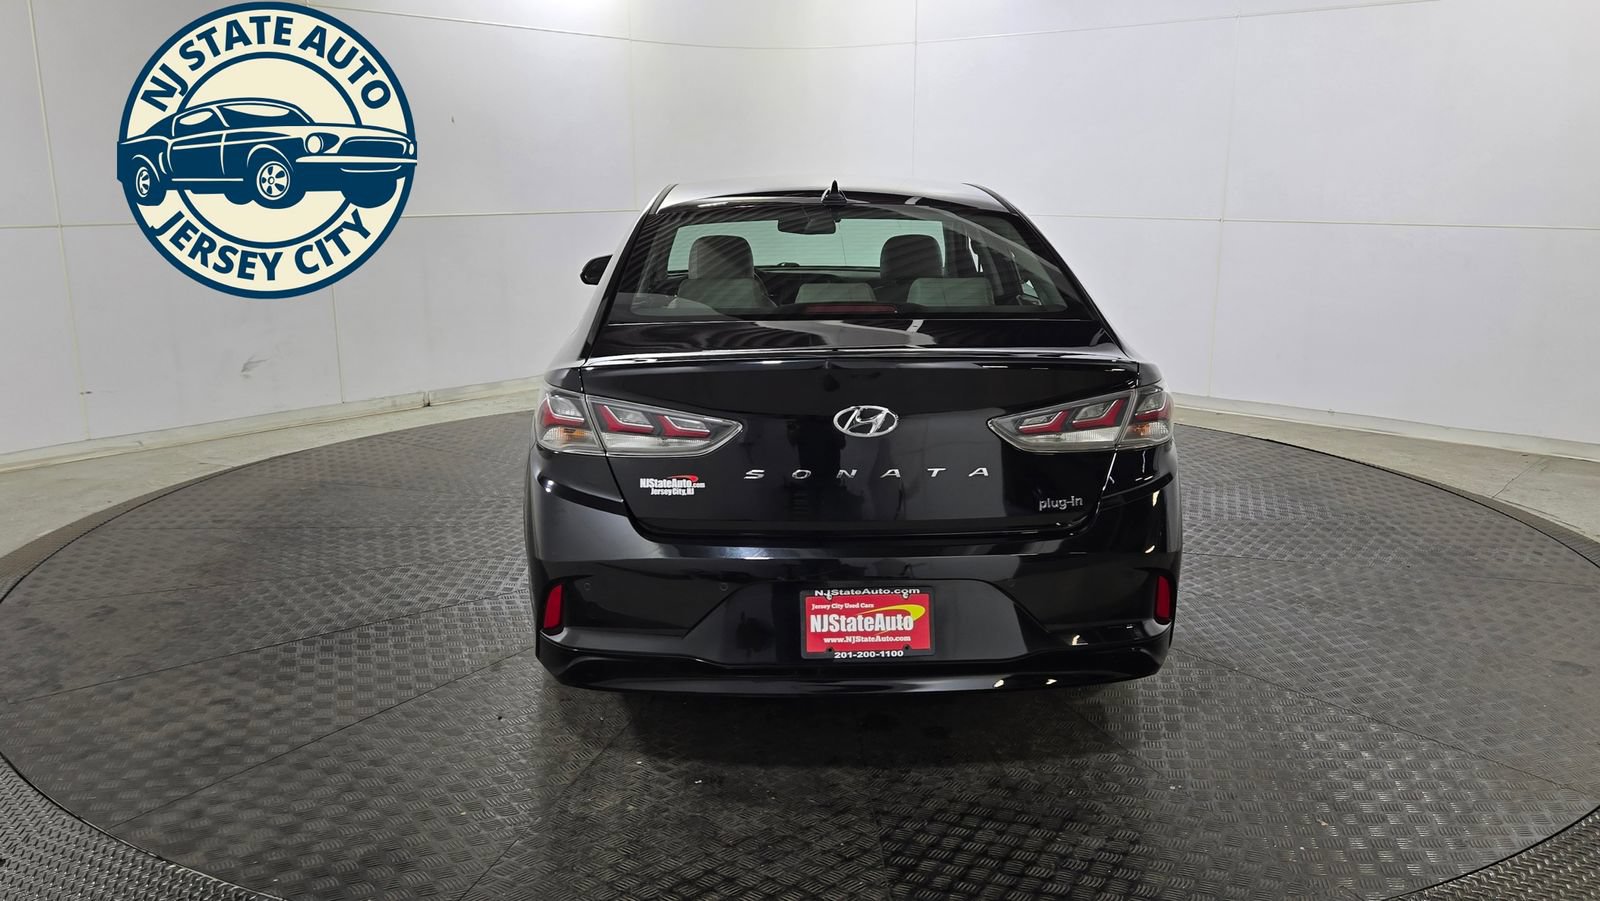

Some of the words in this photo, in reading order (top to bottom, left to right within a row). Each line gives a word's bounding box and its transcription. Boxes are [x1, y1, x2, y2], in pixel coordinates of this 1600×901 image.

[743, 467, 989, 480] SONATA
[650, 488, 672, 496] Jersey
[1039, 495, 1083, 511] plug-in
[815, 588, 920, 597] NJStateAuto.com
[810, 613, 914, 633] NJStateAuto
[823, 635, 911, 644] www.NJStateAuto.com
[834, 650, 904, 659] 201-200-1100
